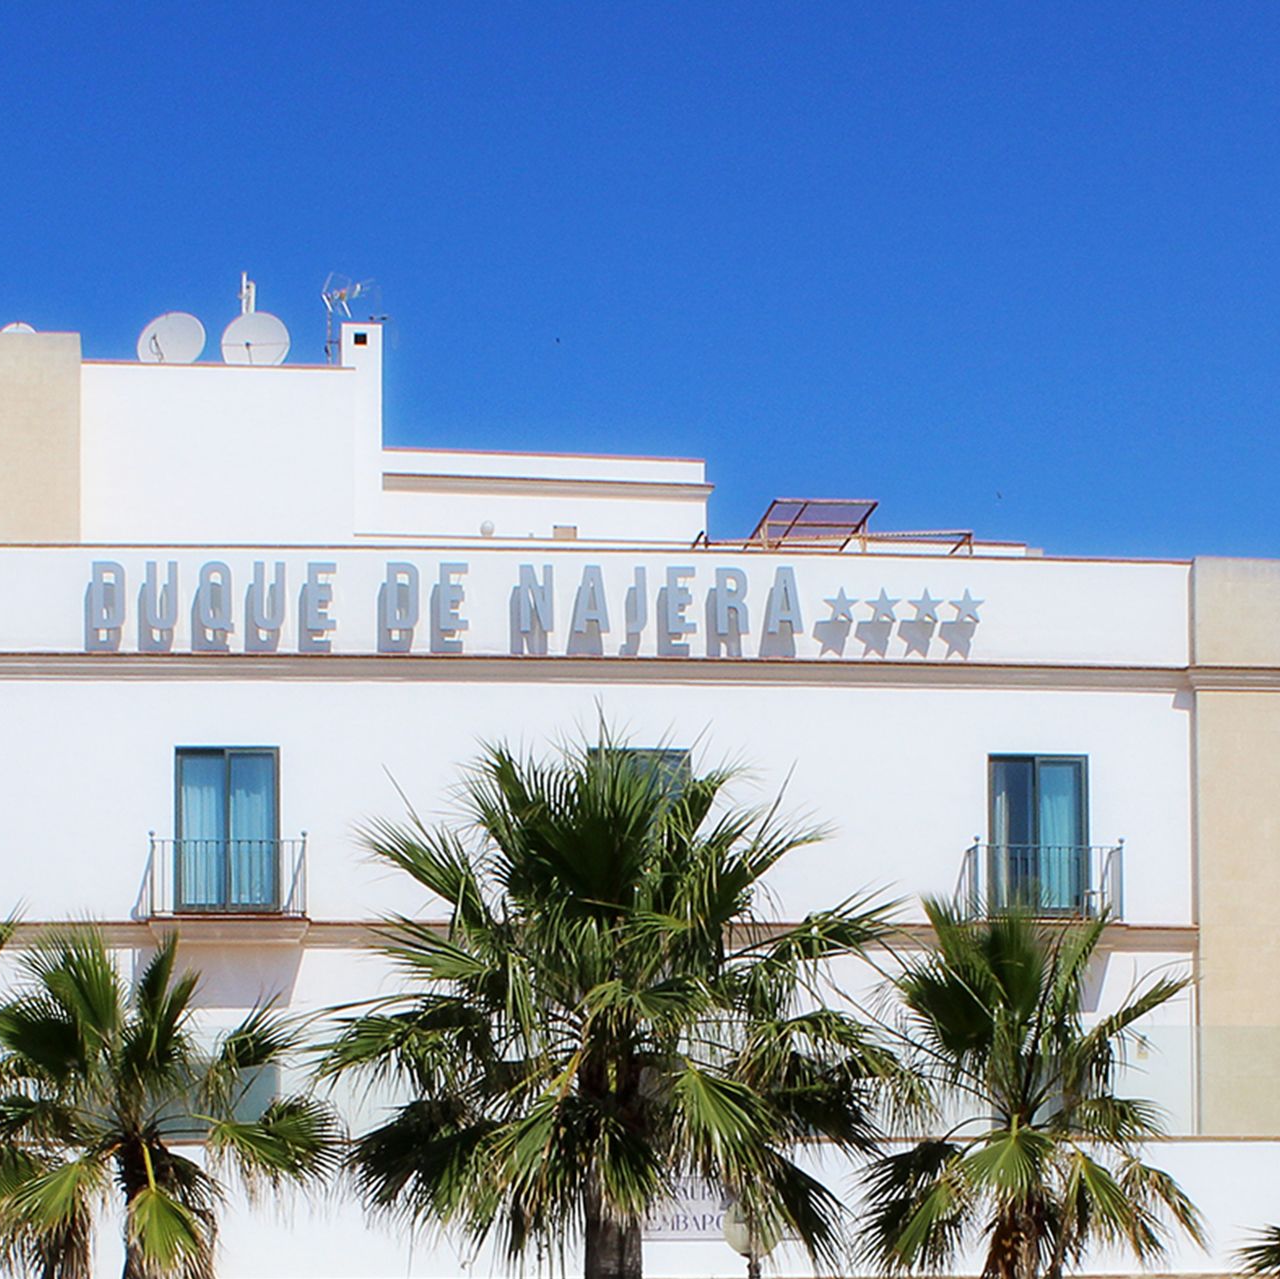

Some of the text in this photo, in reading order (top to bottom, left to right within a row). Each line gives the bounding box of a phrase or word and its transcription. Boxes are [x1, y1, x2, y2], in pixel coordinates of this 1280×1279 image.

[89, 561, 804, 636] DUQUE DE NAJERA
